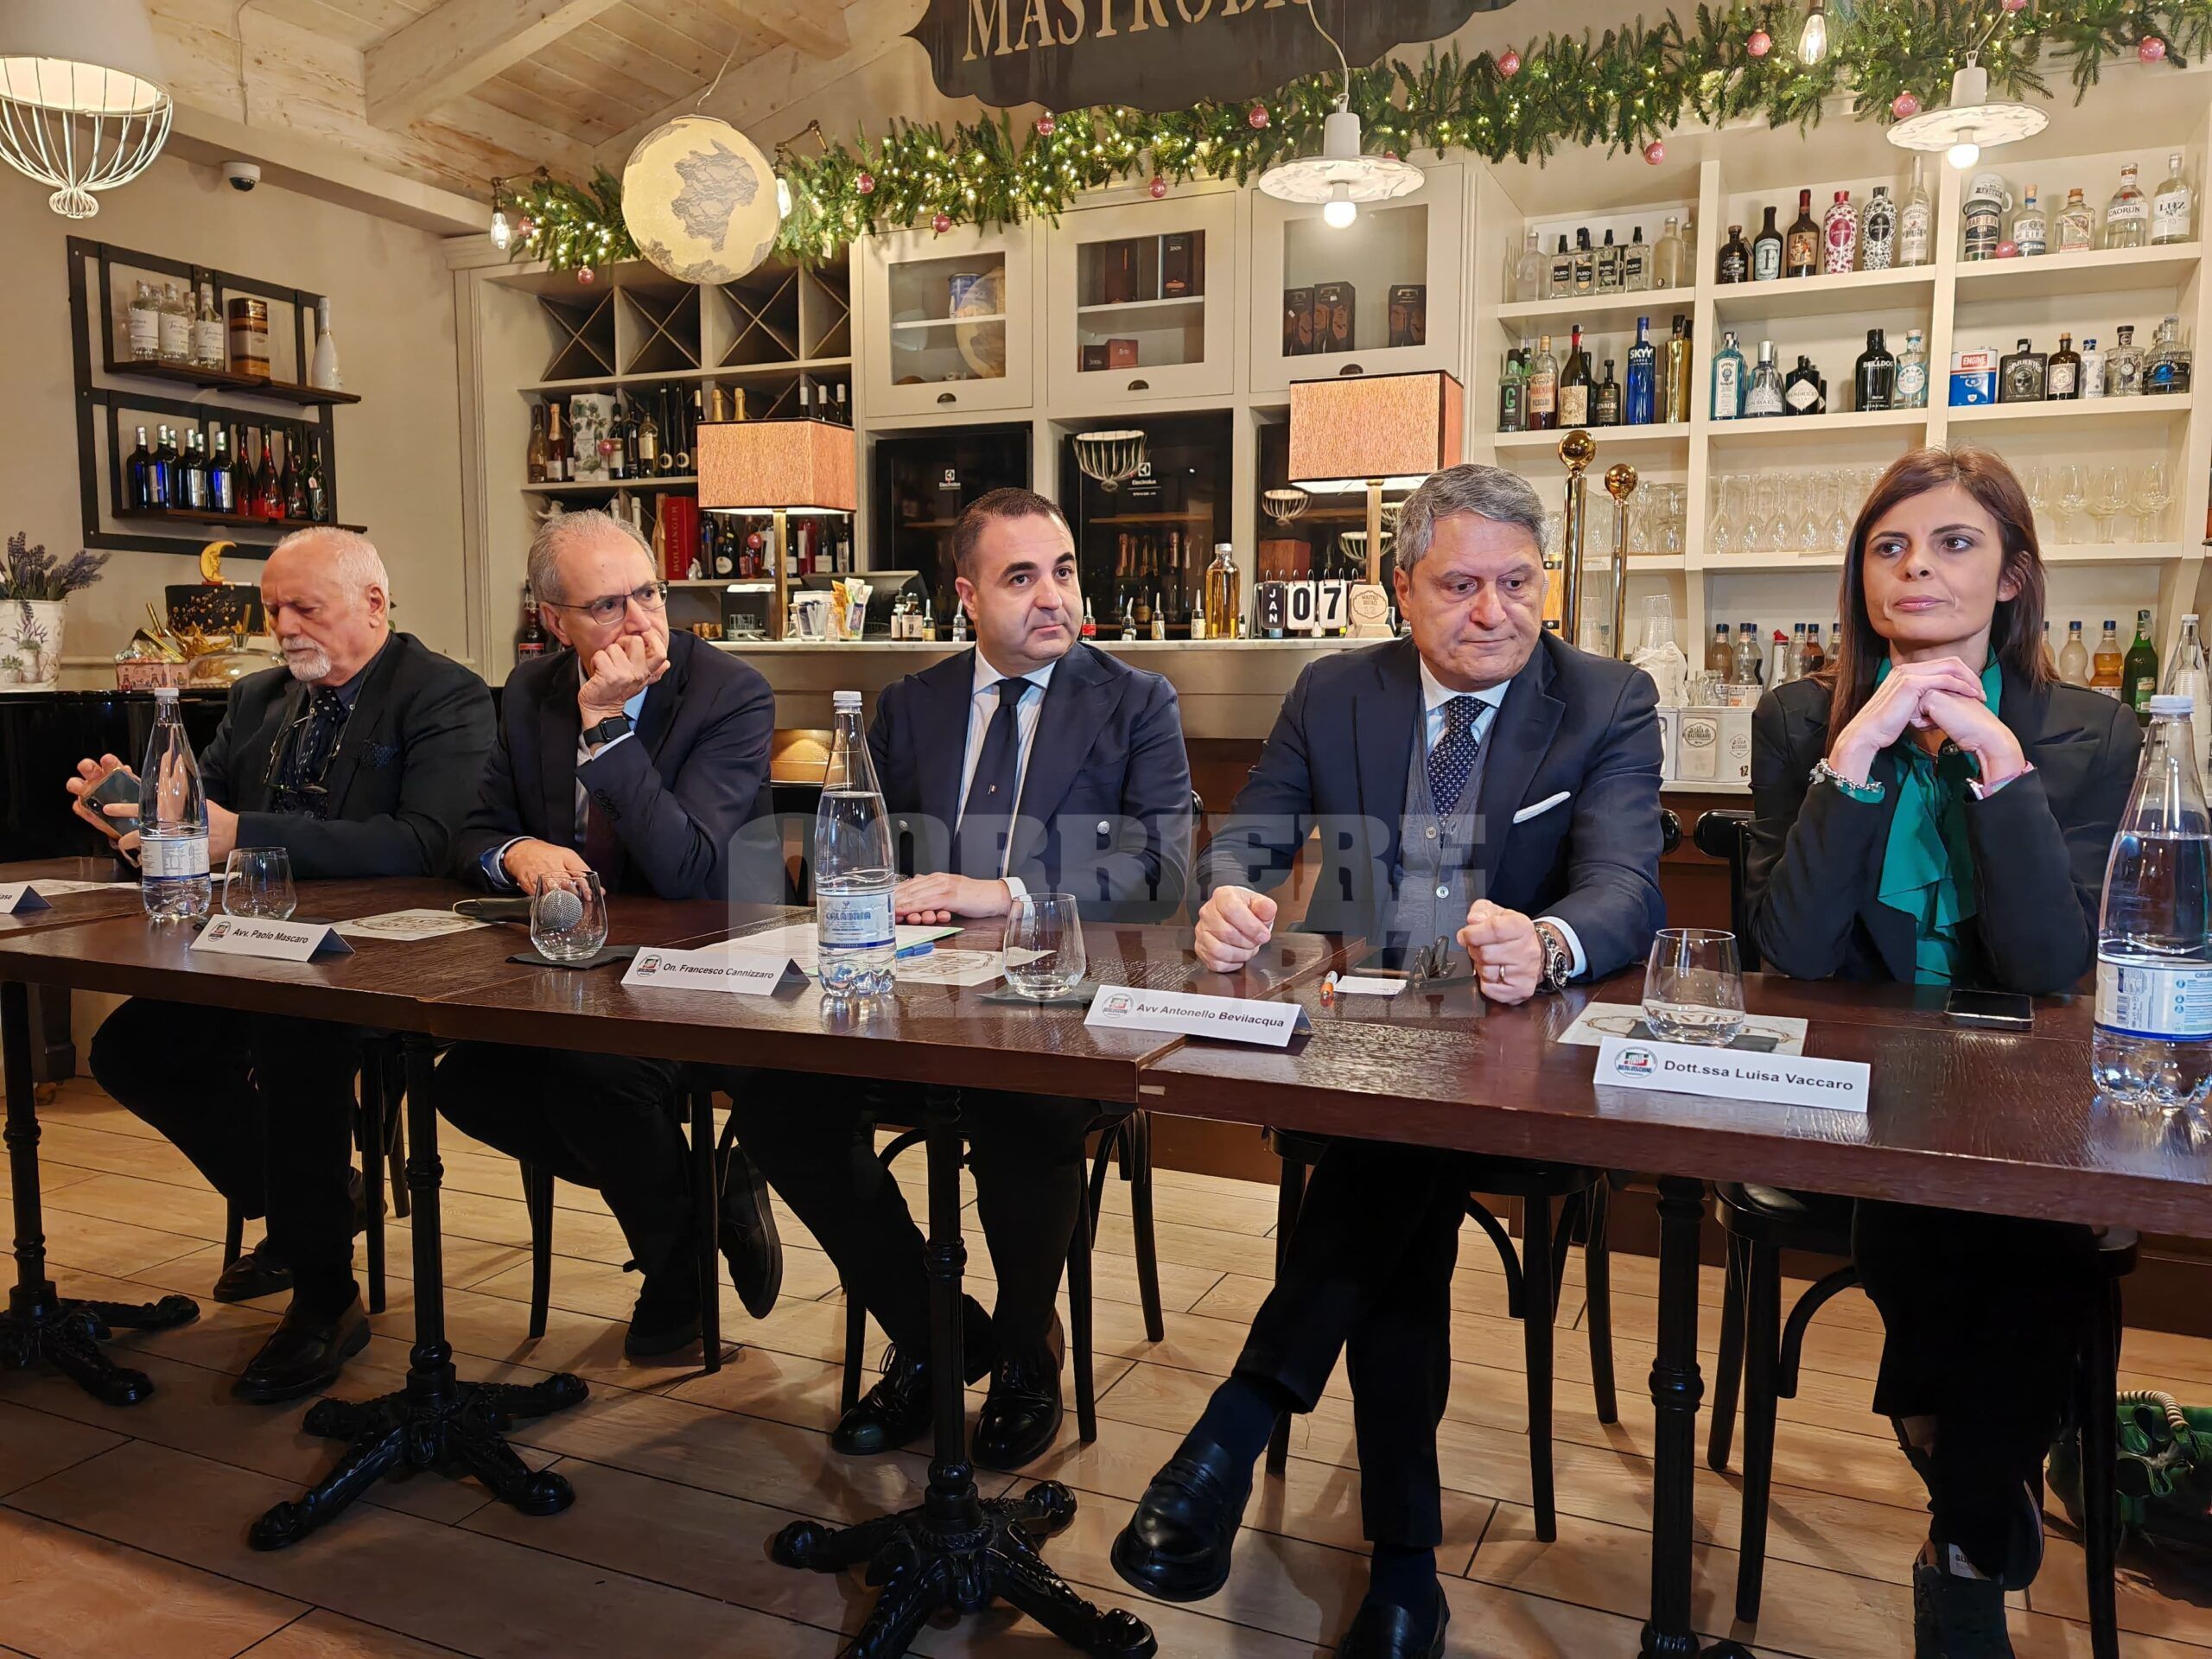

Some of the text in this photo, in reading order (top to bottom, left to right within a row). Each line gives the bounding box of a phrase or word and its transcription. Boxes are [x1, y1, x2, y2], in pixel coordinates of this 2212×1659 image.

[1269, 588, 1278, 623] JAN
[232, 928, 249, 938] Avv.
[251, 930, 274, 940] Paolo
[276, 931, 308, 944] Mascaro
[663, 963, 774, 980] On. Francesco Cannizzaro
[1136, 1003, 1284, 1028] Avv Antonello Bevilacqua
[1664, 1059, 1729, 1077] Dott.ssa
[1735, 1069, 1780, 1083] Luisa
[1785, 1073, 1853, 1091] Vaccaro
